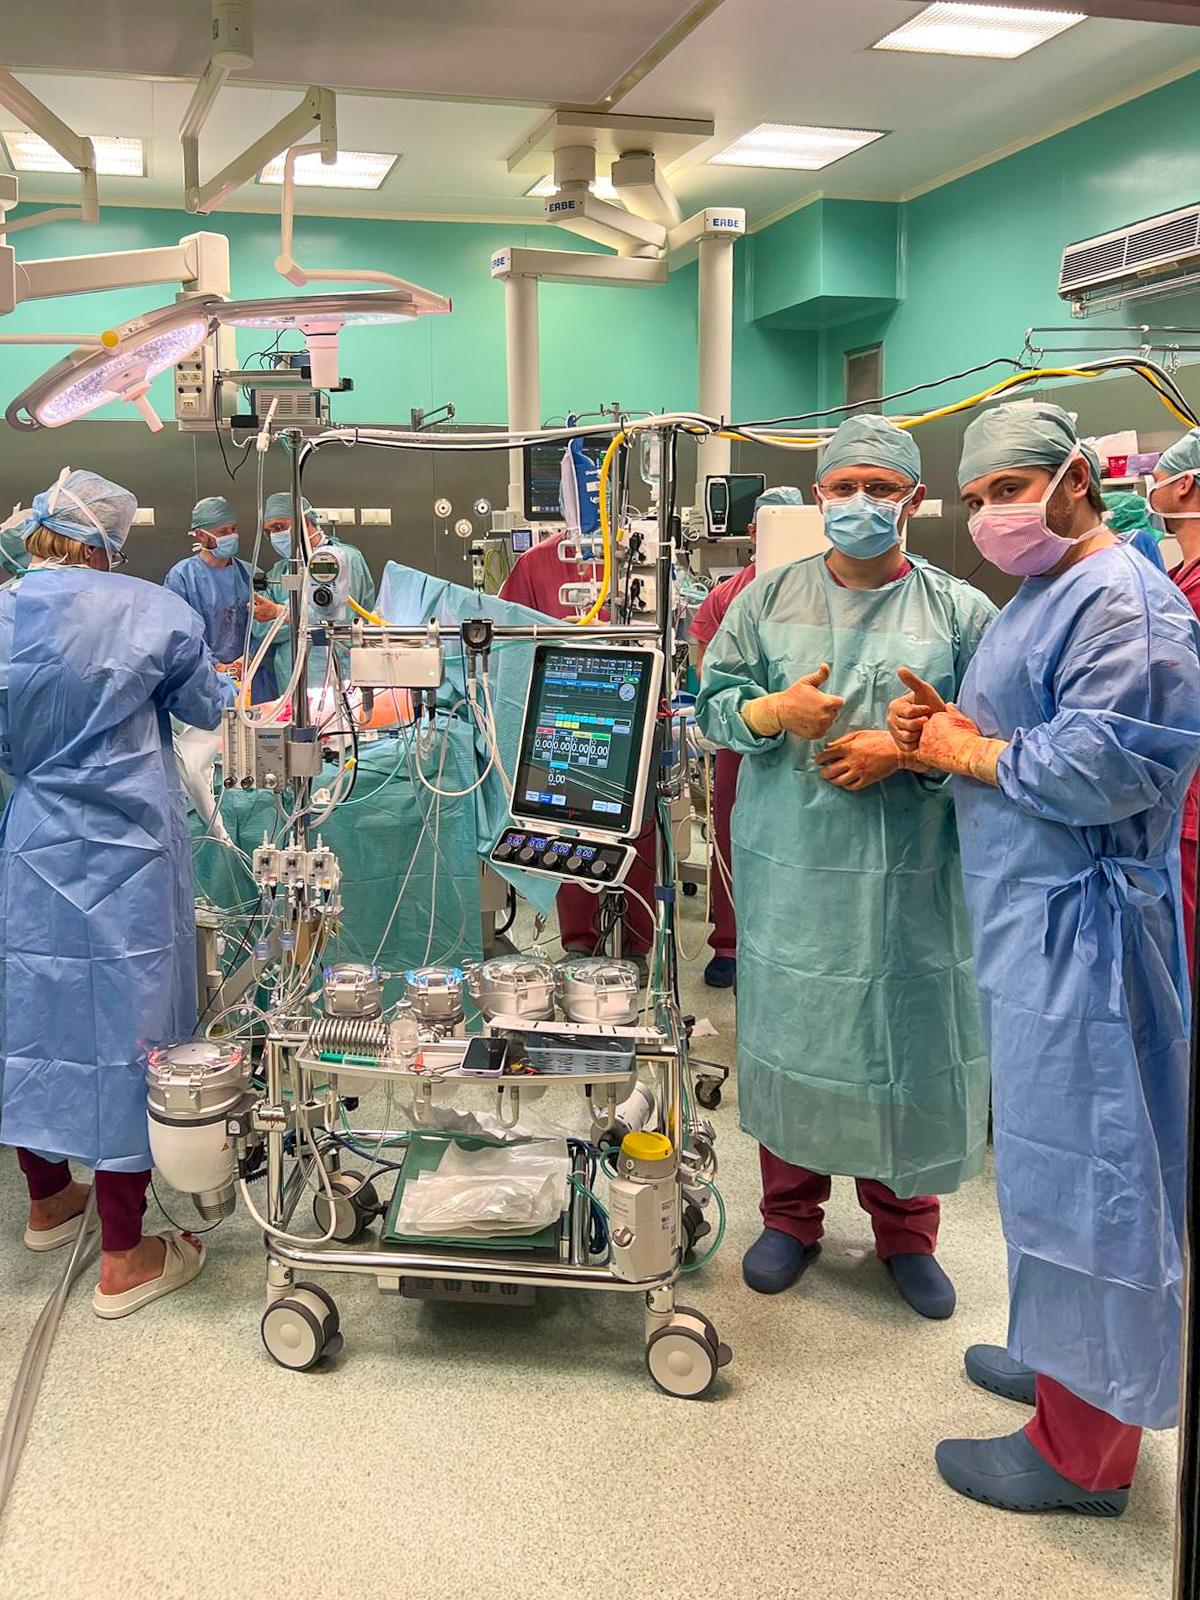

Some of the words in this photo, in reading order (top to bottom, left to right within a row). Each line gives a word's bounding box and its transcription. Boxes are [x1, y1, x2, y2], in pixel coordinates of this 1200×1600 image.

[549, 200, 576, 213] ERBE
[712, 218, 740, 228] ERBE
[535, 739, 552, 749] 0.00
[553, 741, 570, 751] 0.00
[571, 743, 589, 754] 0.00
[590, 745, 608, 756] 0.00
[548, 773, 566, 784] 0.00
